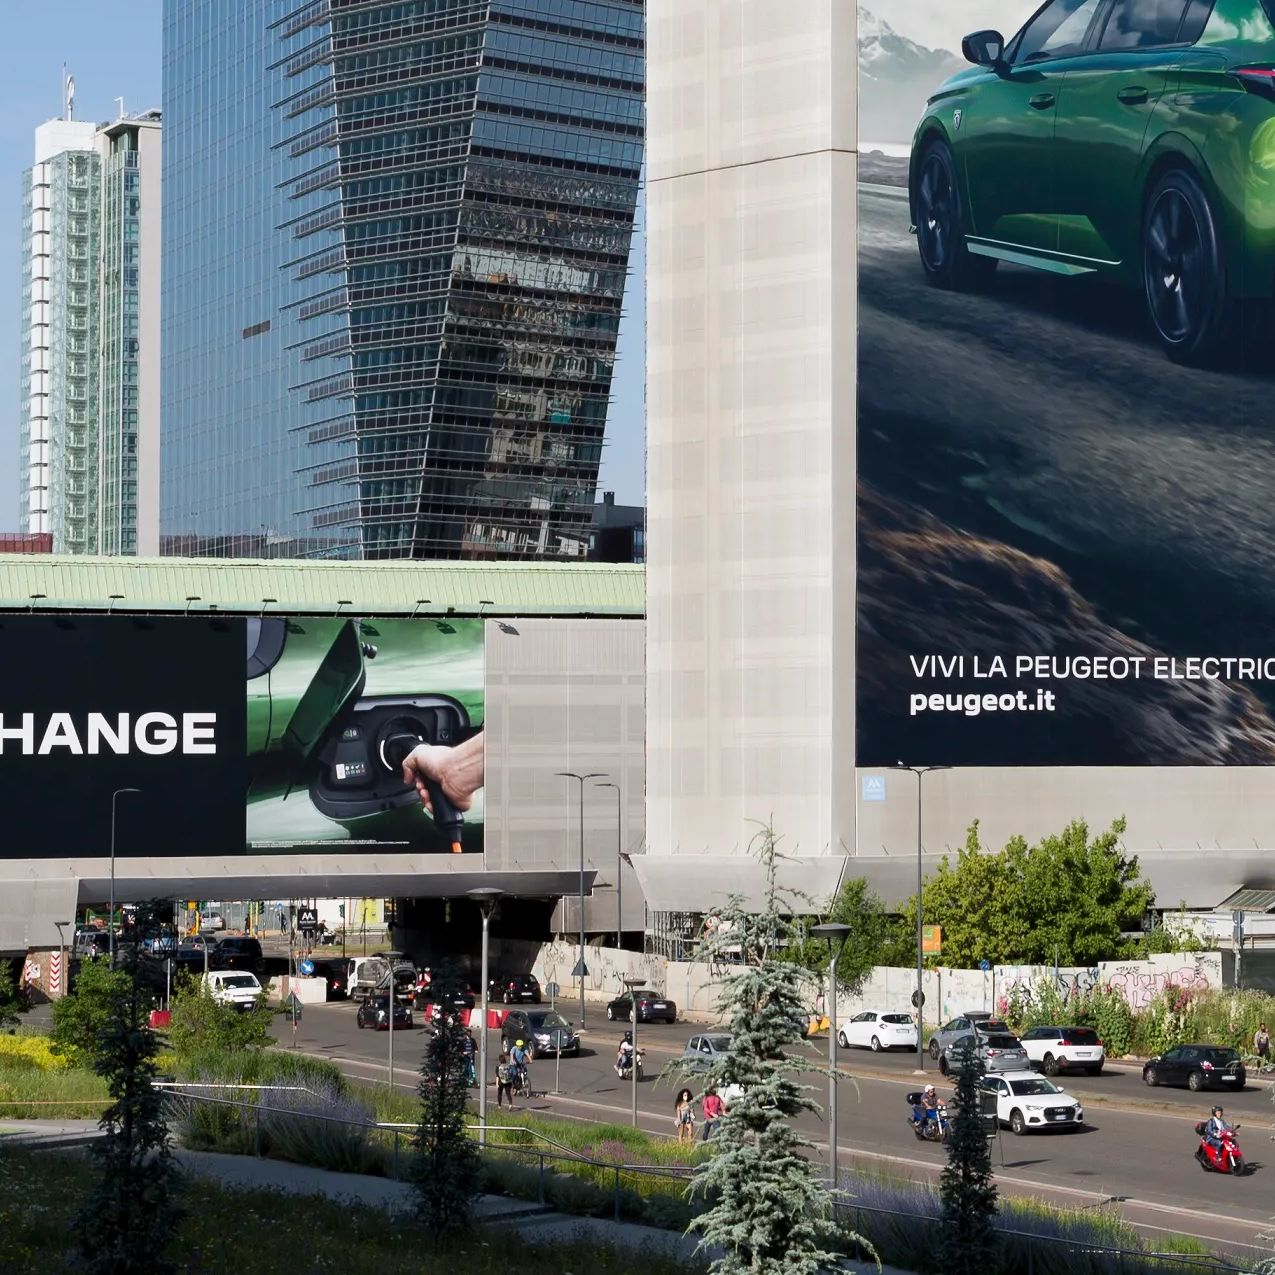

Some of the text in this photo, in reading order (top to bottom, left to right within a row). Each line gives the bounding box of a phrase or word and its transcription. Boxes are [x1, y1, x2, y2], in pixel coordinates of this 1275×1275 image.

[909, 655, 965, 678] VIVI
[974, 655, 1008, 678] LA
[1016, 655, 1146, 679] PEUGEOT
[910, 688, 1056, 716] peugeot.it
